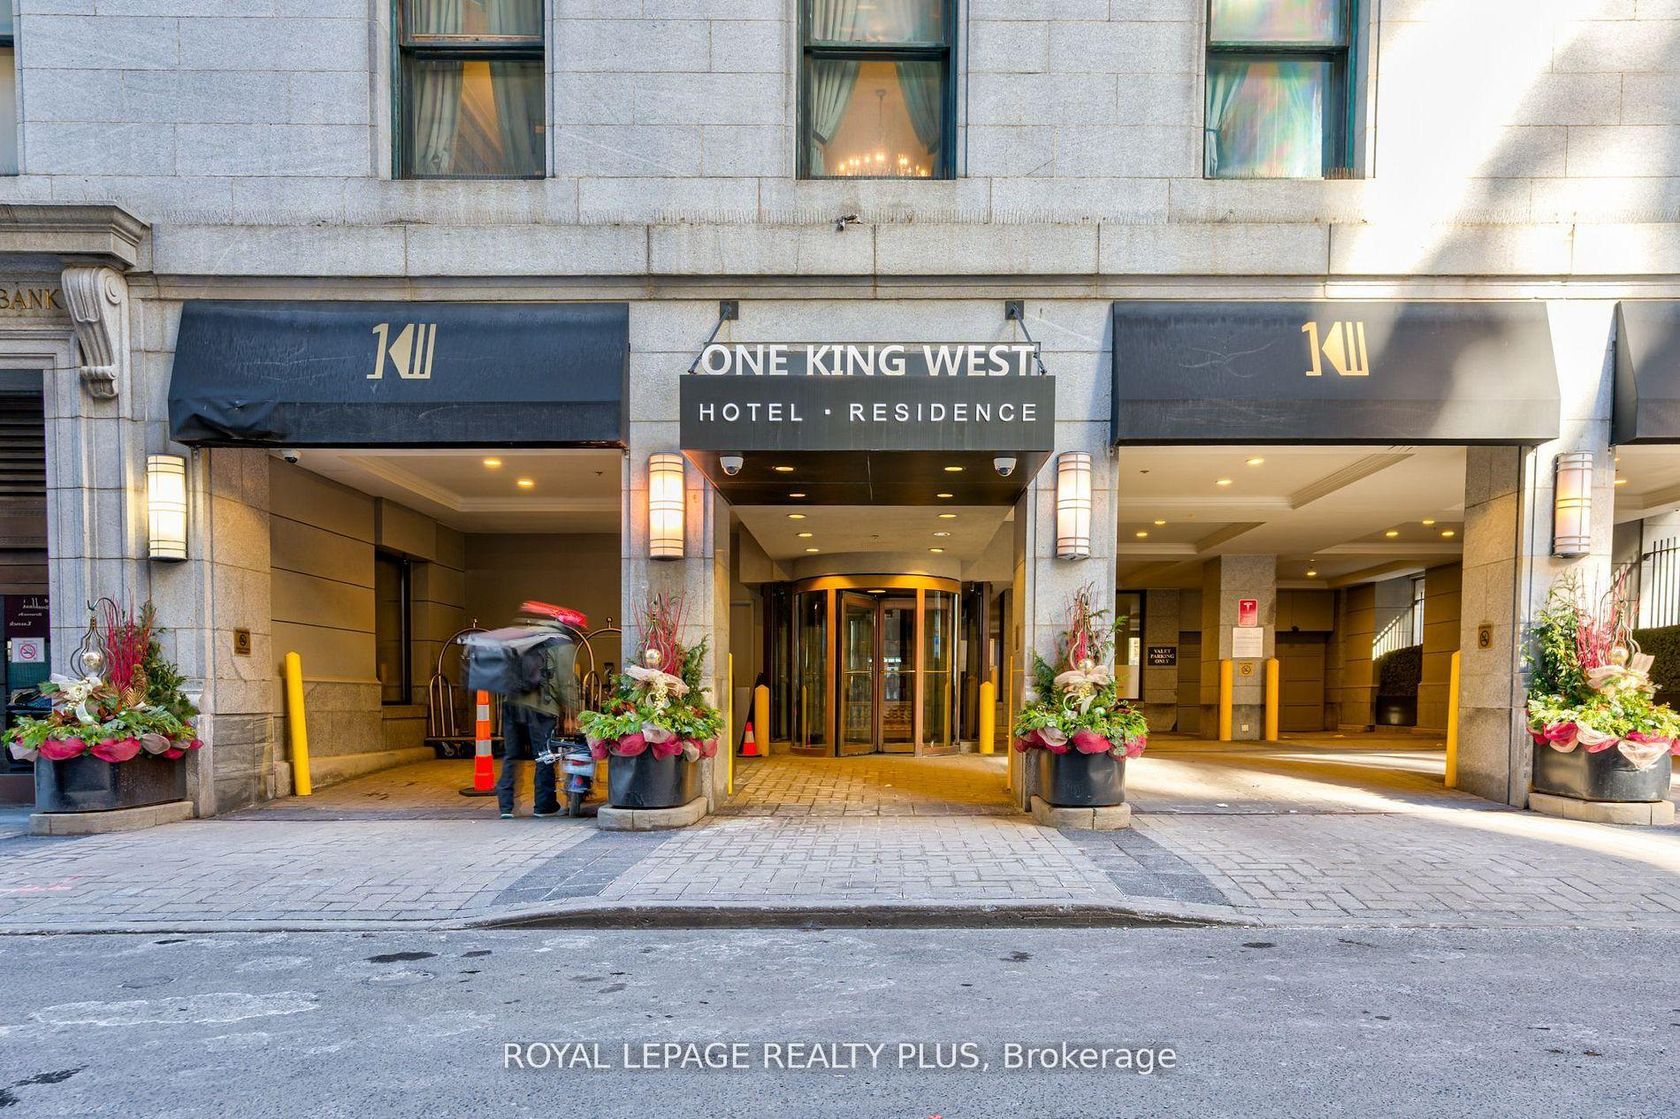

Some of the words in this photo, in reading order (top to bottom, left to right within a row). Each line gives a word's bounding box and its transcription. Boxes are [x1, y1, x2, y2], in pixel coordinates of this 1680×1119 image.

[0, 288, 63, 310] BANK
[701, 344, 789, 377] ONE
[806, 344, 906, 377] KING
[922, 344, 1036, 377] WEST
[699, 403, 803, 422] HOTEL
[850, 403, 1037, 422] RESIDENCE
